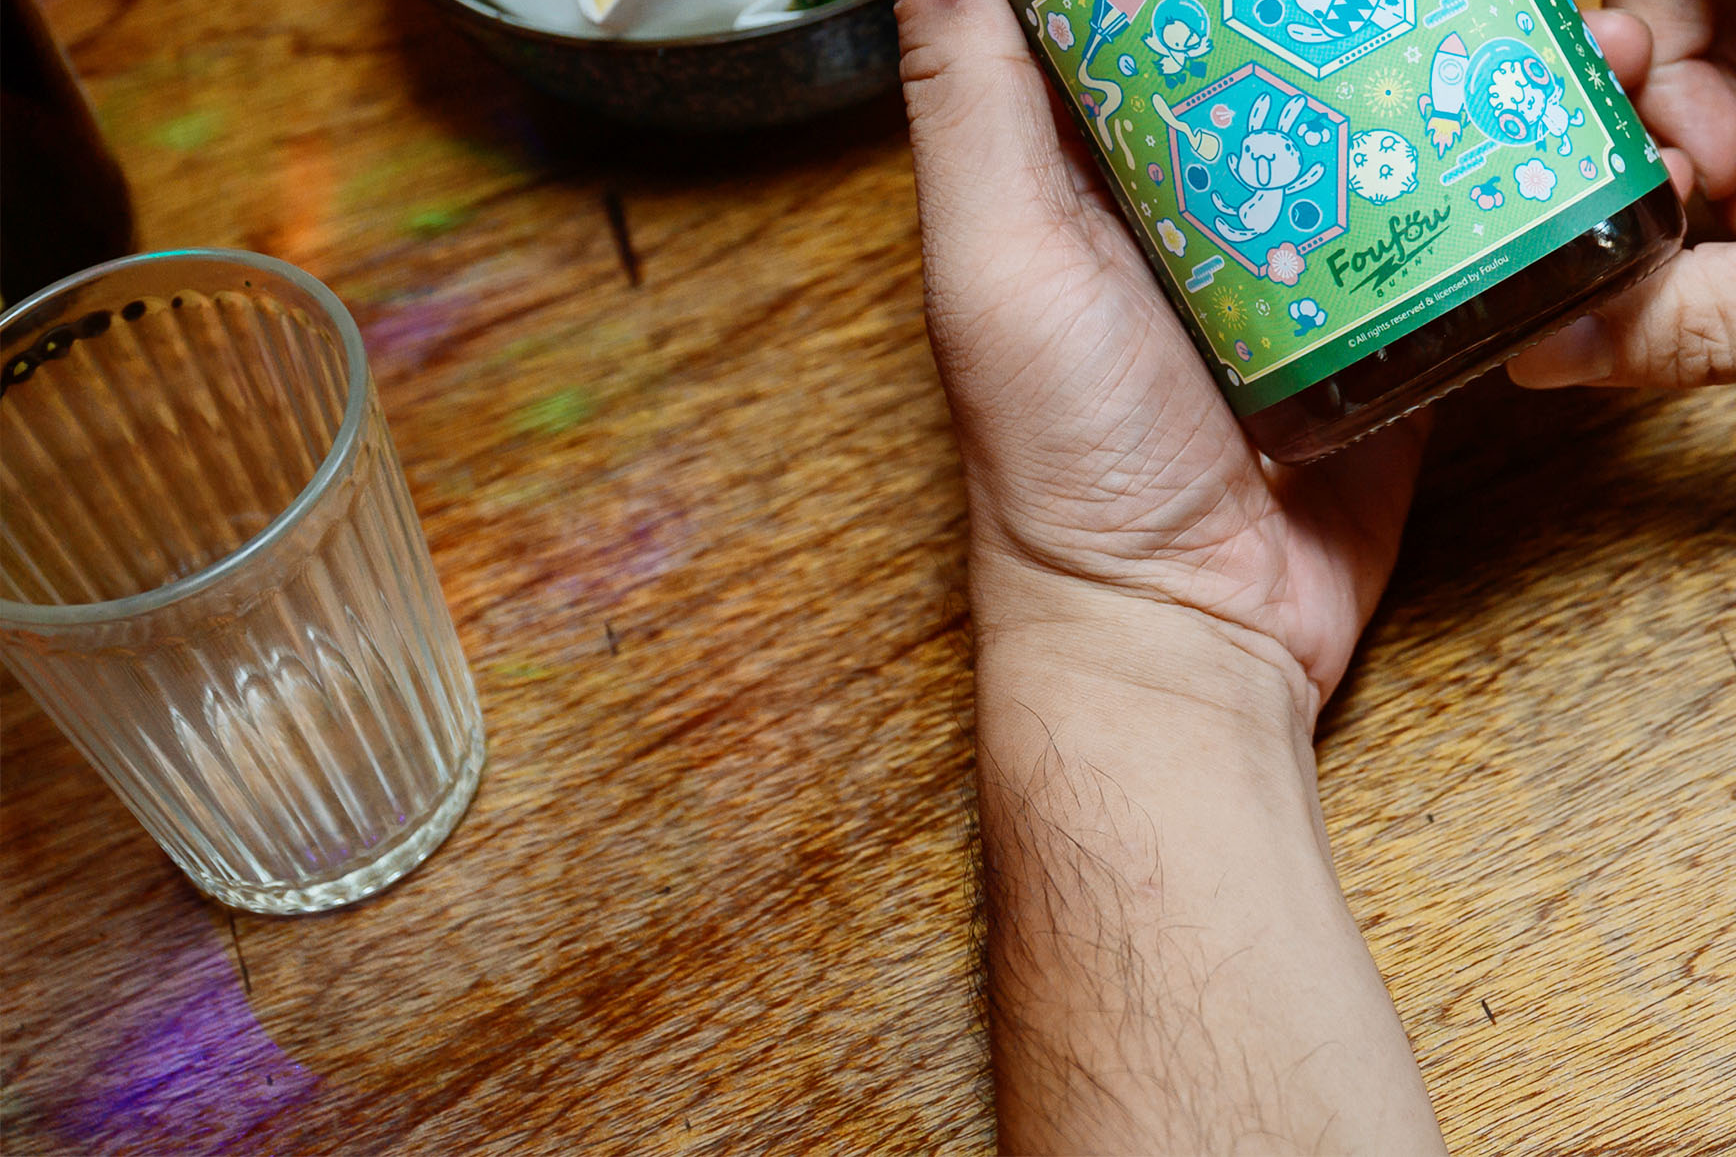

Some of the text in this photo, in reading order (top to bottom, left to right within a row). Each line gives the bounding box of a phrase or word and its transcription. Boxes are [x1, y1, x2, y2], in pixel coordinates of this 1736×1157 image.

[1367, 321, 1391, 338] rights
[1390, 301, 1426, 326] reserved
[1425, 296, 1434, 306] &
[1433, 277, 1468, 301] licensed
[1468, 271, 1480, 283] by
[1479, 254, 1509, 276] Foufou
[1377, 247, 1433, 298] BUNNY
